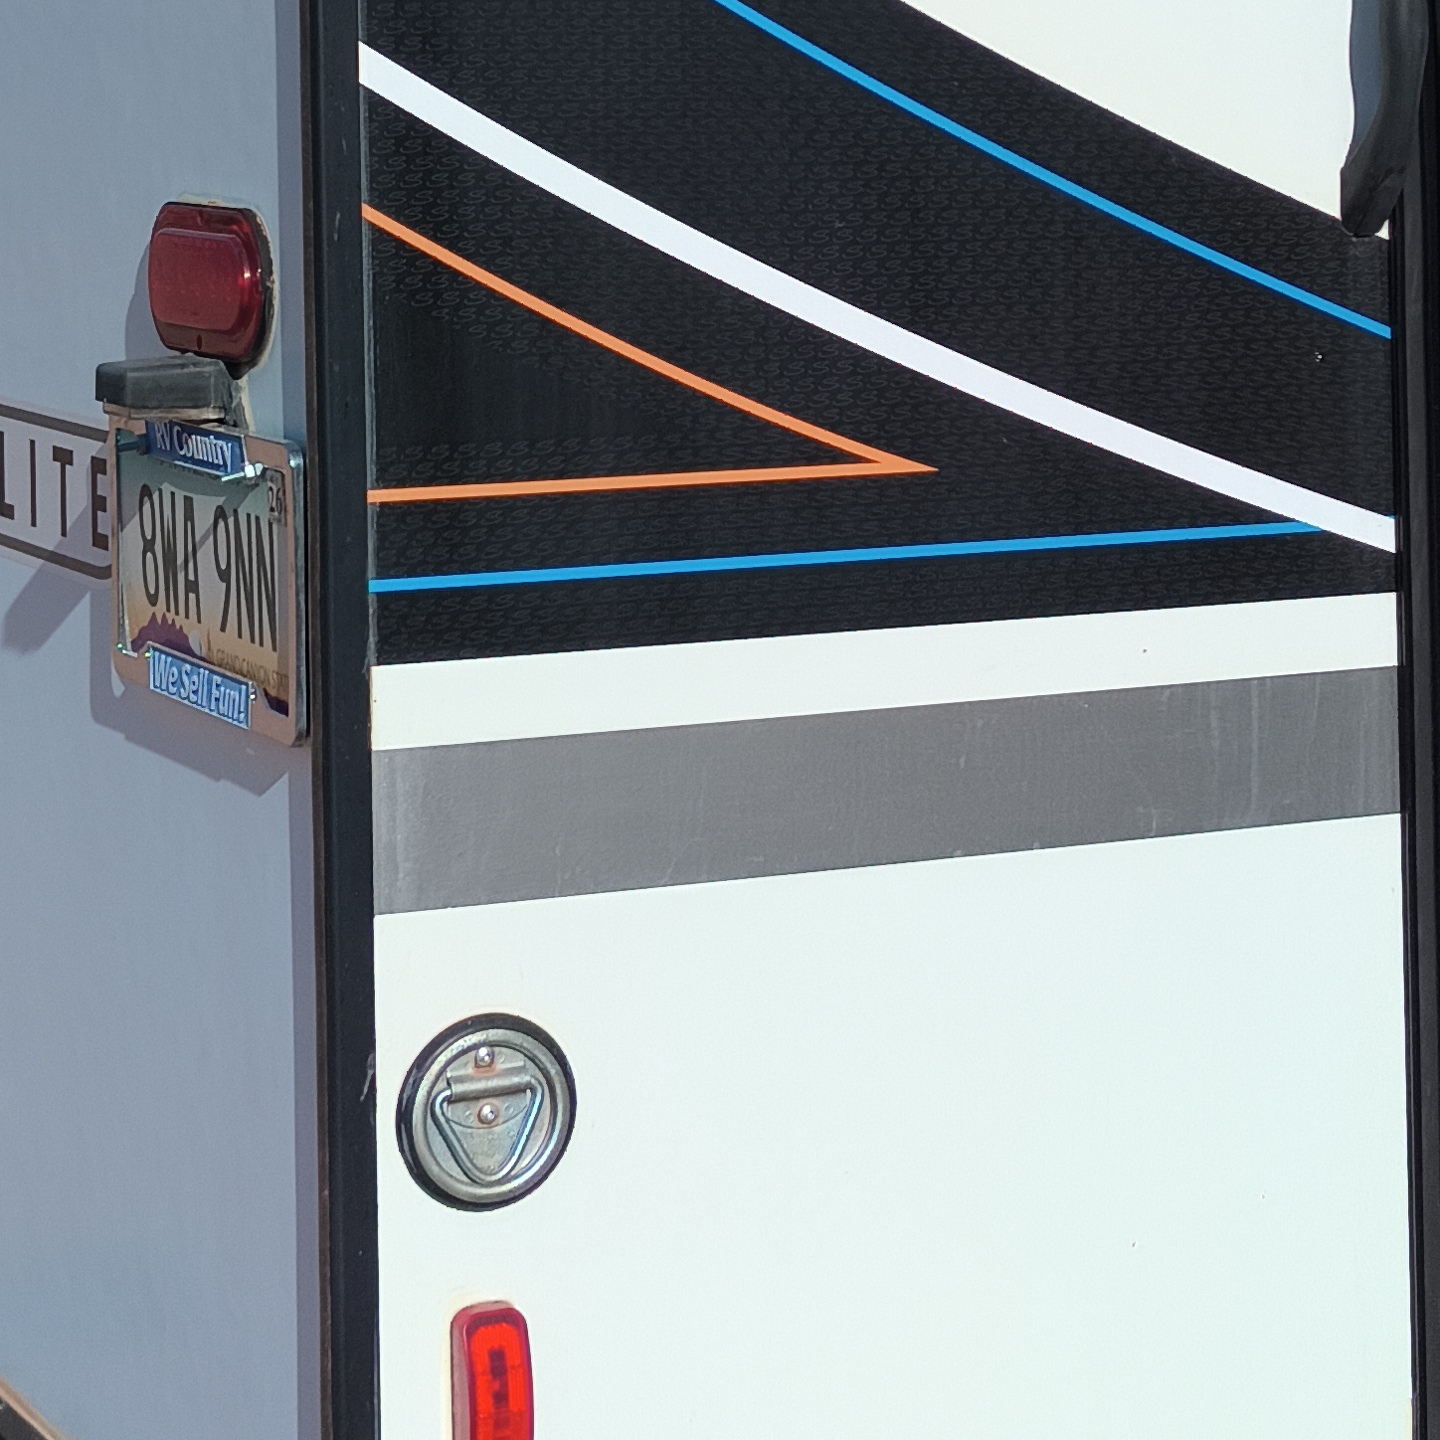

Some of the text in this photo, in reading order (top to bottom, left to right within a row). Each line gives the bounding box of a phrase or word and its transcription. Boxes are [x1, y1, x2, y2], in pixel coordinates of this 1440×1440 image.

[173, 425, 233, 474] Country
[138, 483, 278, 653] 8WA 9NN
[154, 651, 247, 724] We Sell Fun!
